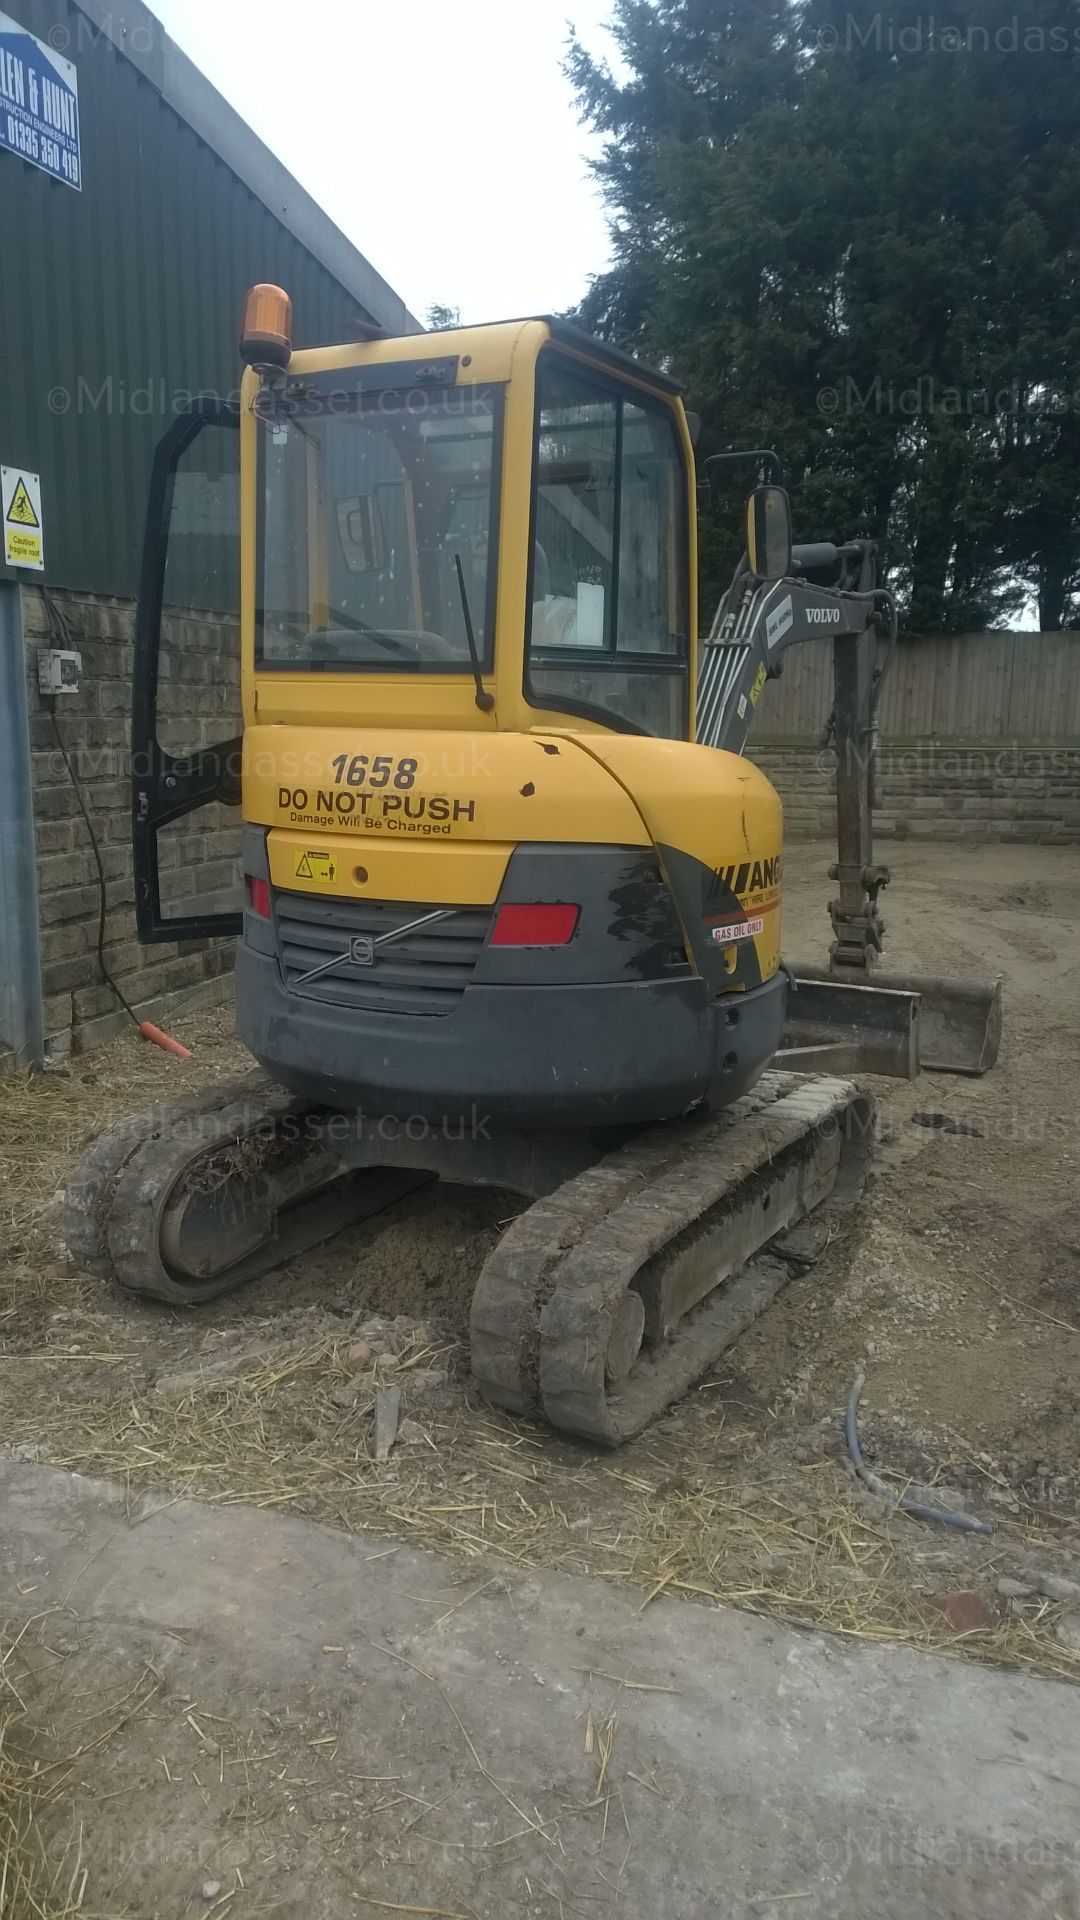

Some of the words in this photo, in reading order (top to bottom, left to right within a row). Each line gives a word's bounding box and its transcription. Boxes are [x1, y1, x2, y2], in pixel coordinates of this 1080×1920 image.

[0, 47, 25, 107] LEN
[28, 67, 39, 116] &
[42, 76, 75, 139] HUNT
[7, 115, 39, 159] 01335
[40, 135, 60, 172] 350
[62, 148, 79, 183] 419
[33, 117, 66, 147] ENGINEERS
[66, 137, 77, 153] LTD
[9, 543, 28, 555] fragile
[28, 548, 40, 557] roof
[13, 535, 36, 547] Caution
[805, 608, 840, 623] VOLVO
[332, 753, 418, 790] 1658
[278, 787, 308, 810] DO
[316, 790, 373, 814] NOT
[382, 794, 476, 822] PUSH
[290, 811, 334, 826] Damage
[364, 818, 383, 829] Be
[387, 819, 451, 835] Charged
[715, 927, 732, 941] GAS
[733, 923, 746, 938] OIL
[747, 920, 762, 934] ONLY
